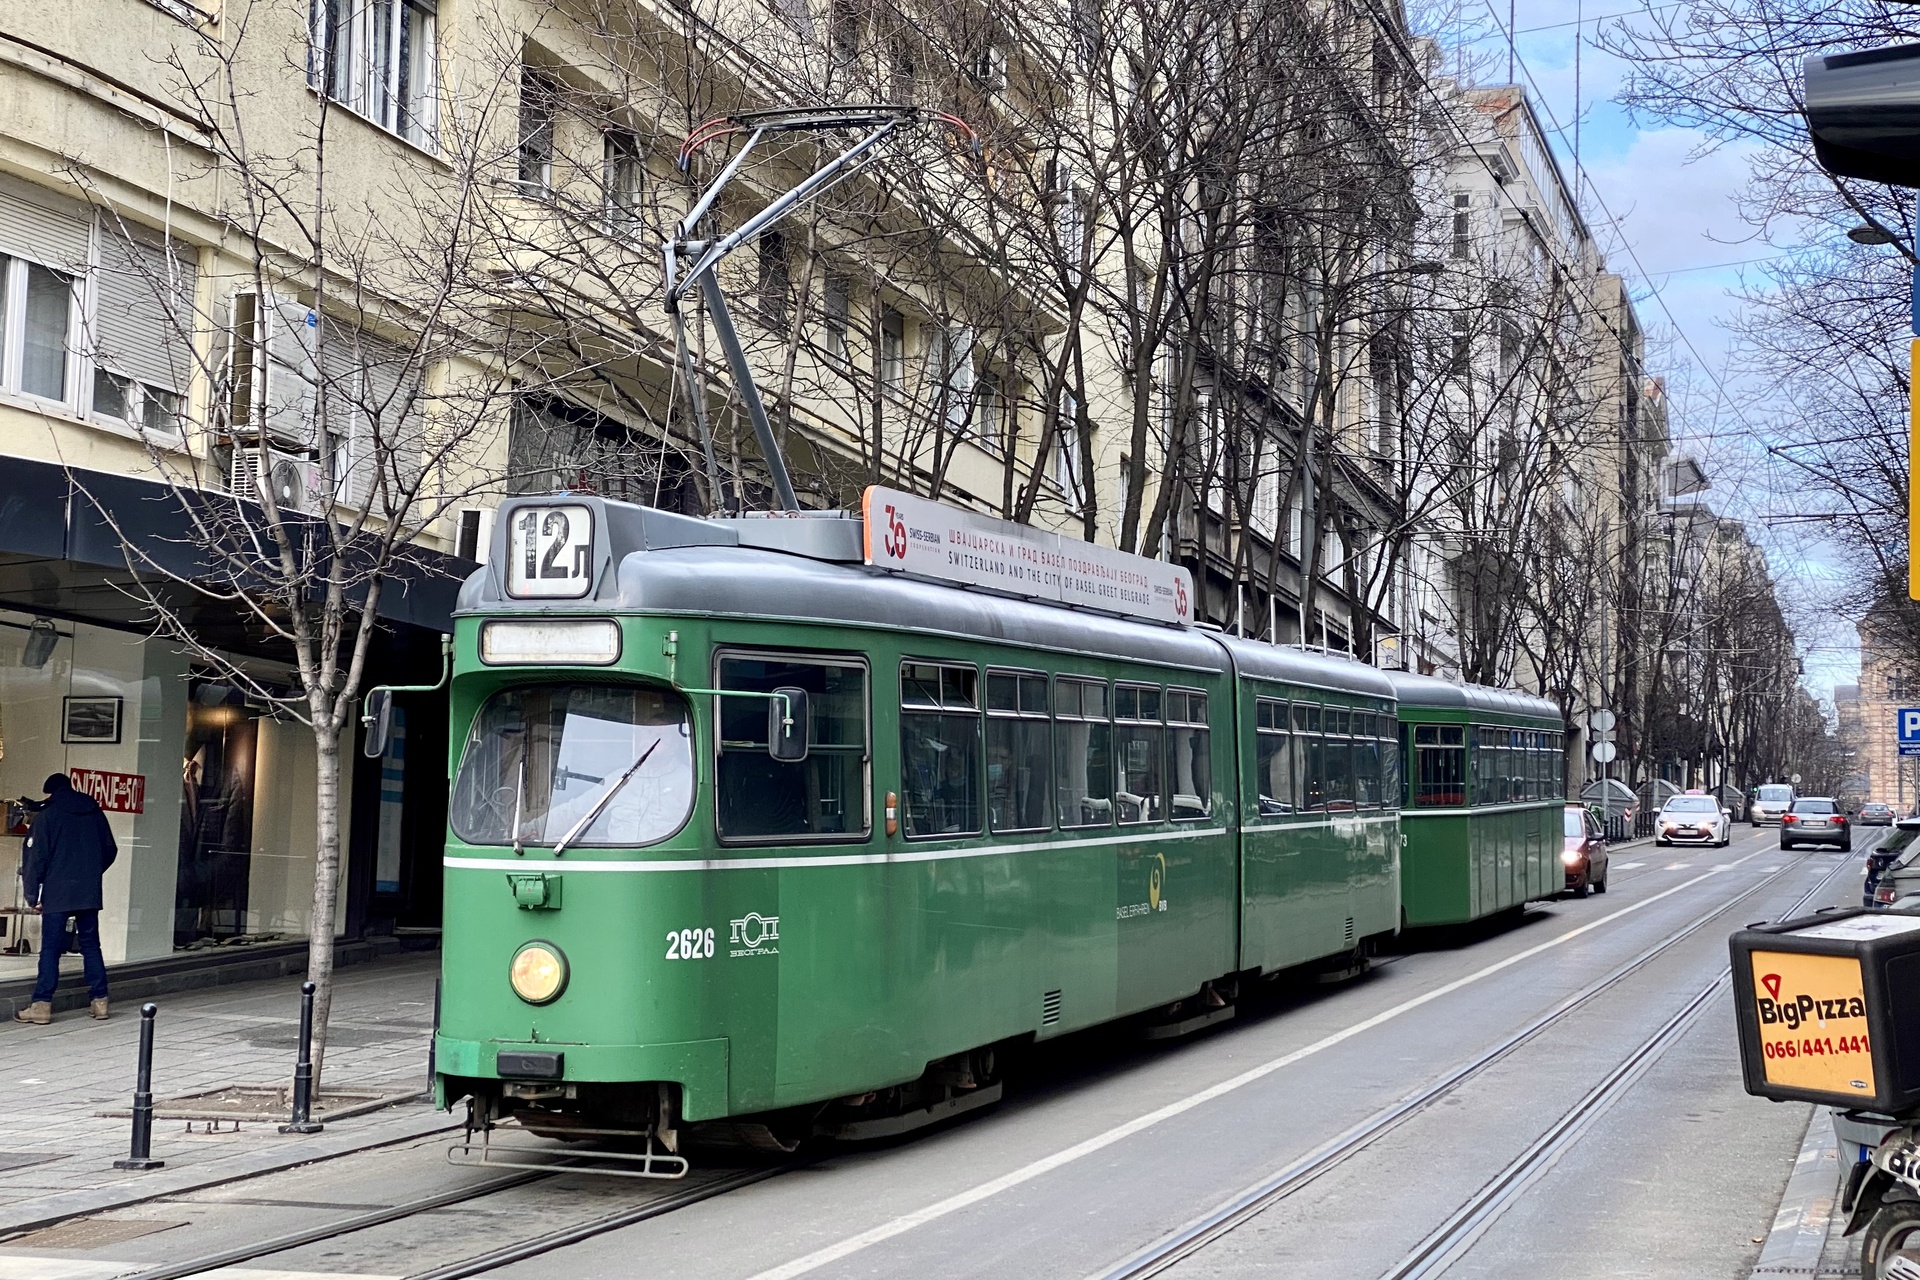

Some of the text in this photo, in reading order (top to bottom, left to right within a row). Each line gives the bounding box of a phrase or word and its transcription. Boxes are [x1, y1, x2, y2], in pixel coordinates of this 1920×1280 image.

[909, 527, 941, 545] SWISS-SERBIAN
[910, 541, 941, 554] COOPERATION
[948, 529, 1149, 589] ШВАЈЦАРСКА И ГРАД БАЗЕЛ ПОЗДРАВЉАЈУ БЕОГРАД
[948, 550, 1005, 575] SWITZERLAND
[1008, 564, 1024, 579] AND
[1027, 568, 1041, 583] THE
[1044, 572, 1061, 587] CITY
[1064, 576, 1073, 590] OF
[1075, 579, 1096, 595] BASEL
[1098, 584, 1118, 598] GREET
[1120, 588, 1150, 606] BELGRADE
[1904, 711, 1920, 738] P
[665, 927, 715, 960] 2626
[729, 946, 780, 958] БЕОГРАД
[1757, 994, 1866, 1030] BigPizza
